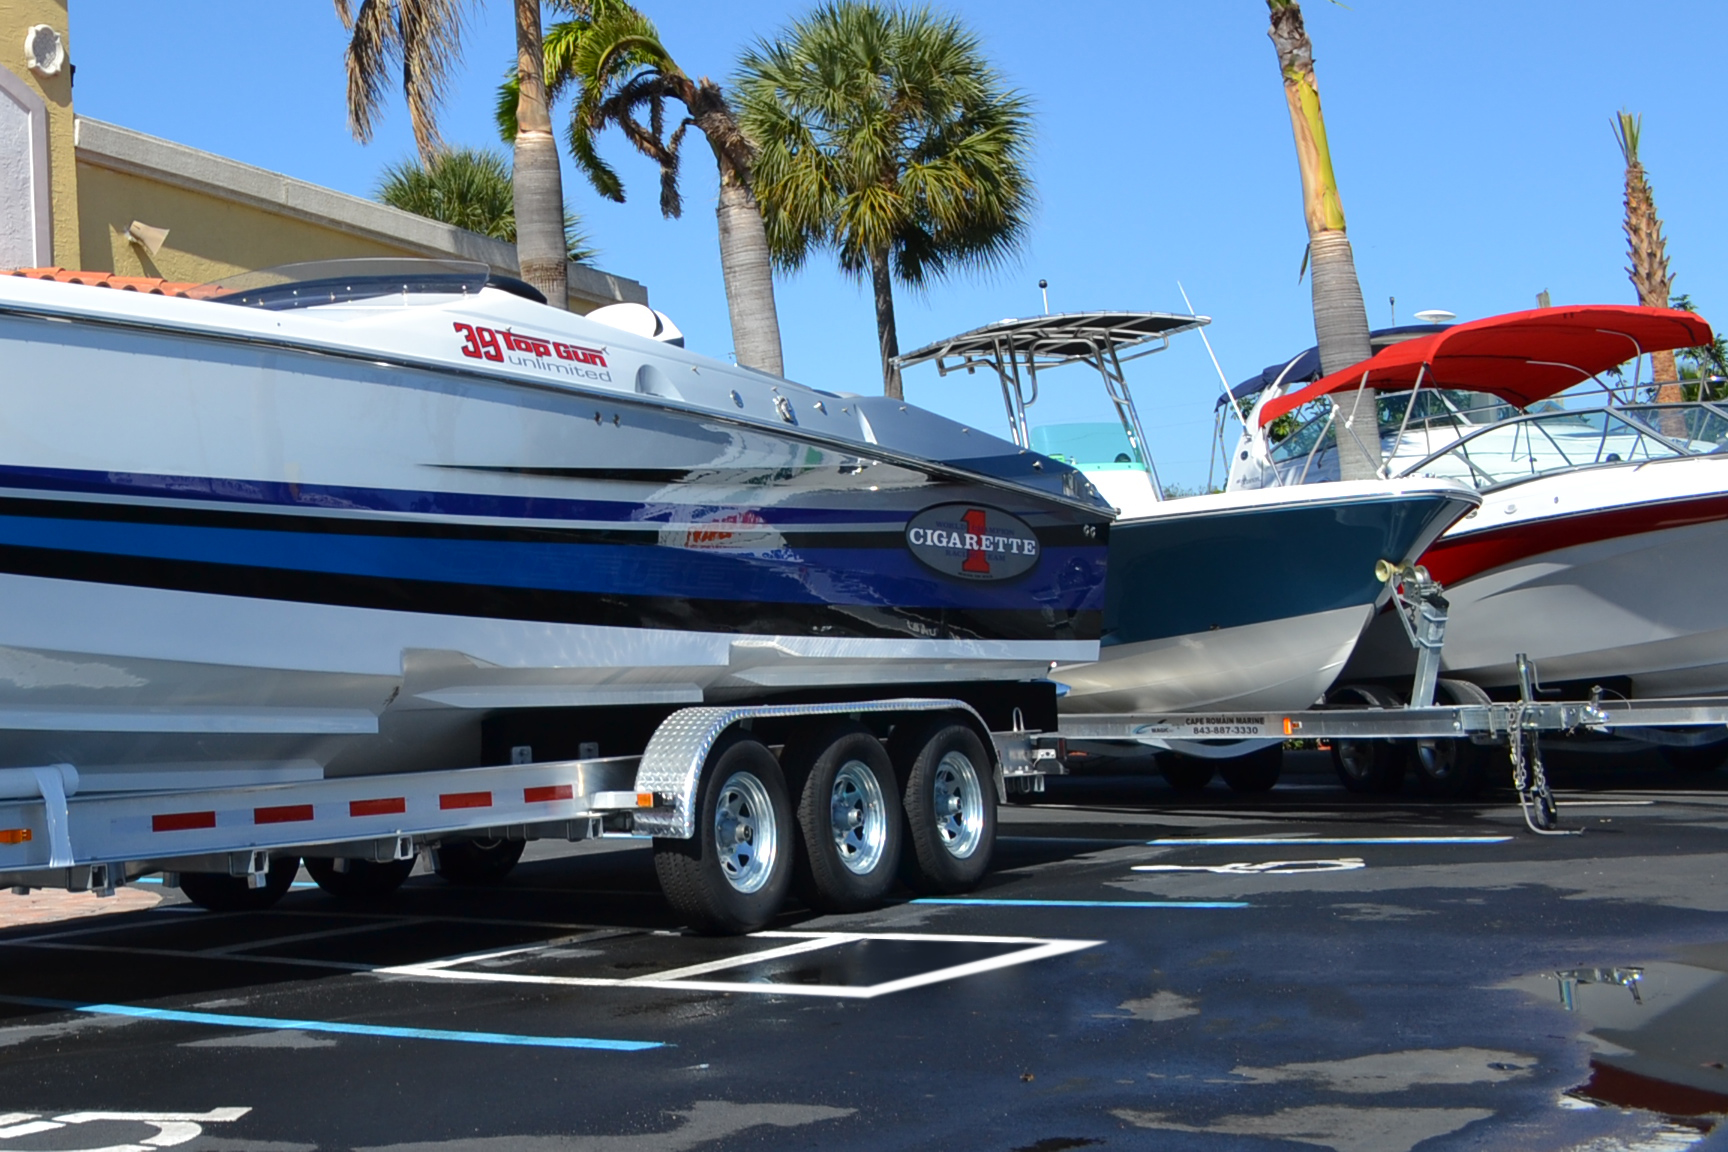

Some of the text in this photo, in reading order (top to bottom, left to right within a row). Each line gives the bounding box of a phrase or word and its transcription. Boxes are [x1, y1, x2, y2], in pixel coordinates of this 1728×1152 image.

[453, 322, 504, 363] 39
[508, 354, 613, 383] unlimited
[935, 520, 967, 531] WORLD
[909, 528, 1036, 555] CIGARETTE
[1185, 716, 1265, 726] CAPE ROMAIN MARINE
[1193, 726, 1259, 735] 843-887-3330
